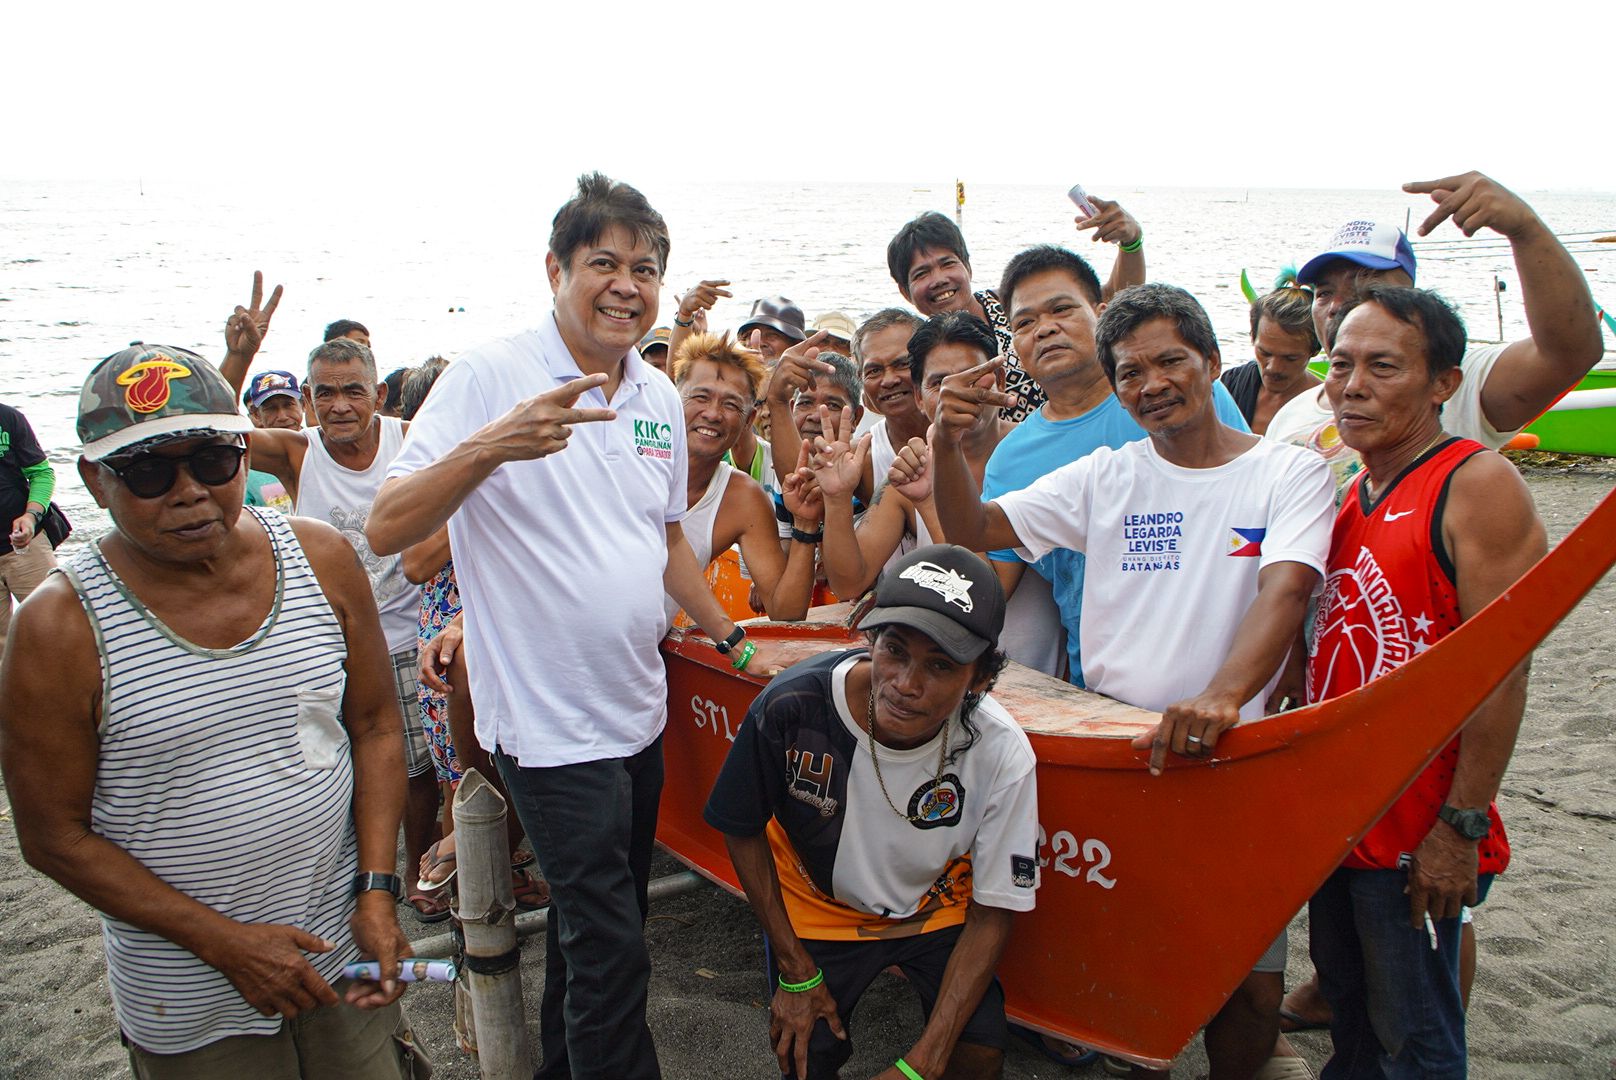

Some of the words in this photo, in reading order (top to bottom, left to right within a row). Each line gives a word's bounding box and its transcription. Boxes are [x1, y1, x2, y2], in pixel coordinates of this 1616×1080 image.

[1124, 512, 1183, 526] LEANDRO
[1125, 525, 1182, 539] LEGARDA
[1129, 539, 1177, 552] LEVISTE
[1122, 561, 1180, 572] BATANGAS
[691, 695, 741, 743] STL
